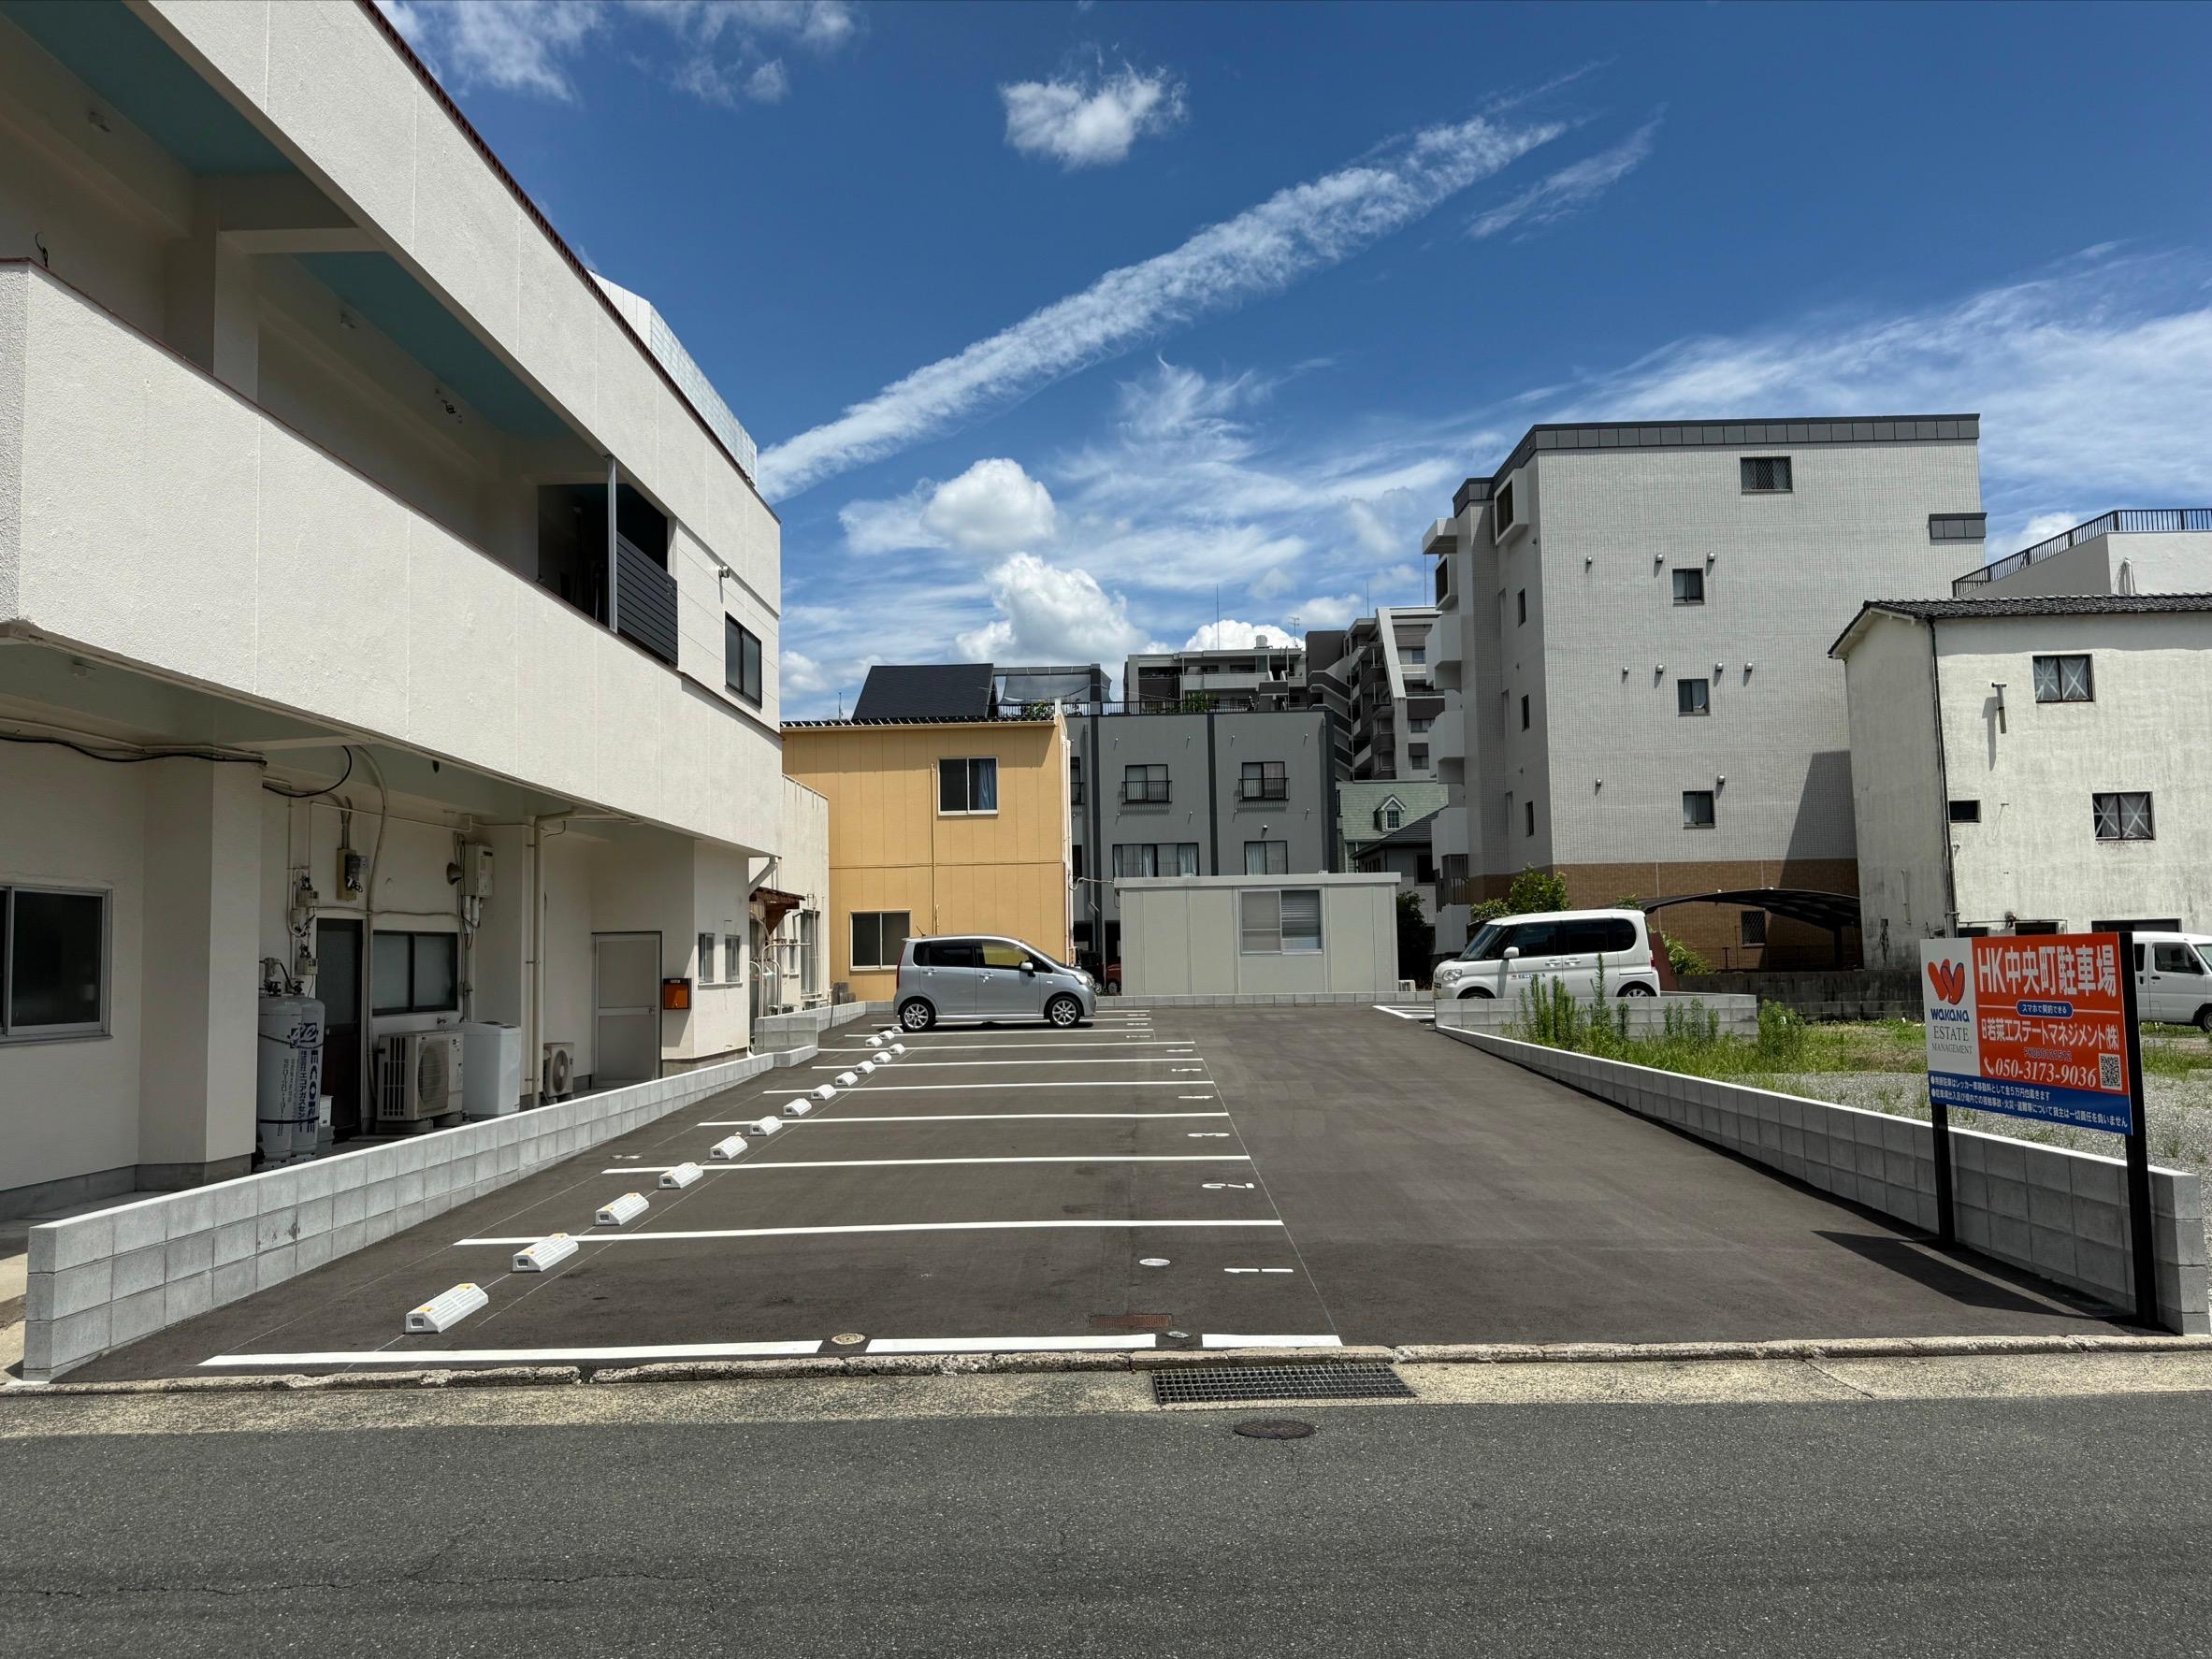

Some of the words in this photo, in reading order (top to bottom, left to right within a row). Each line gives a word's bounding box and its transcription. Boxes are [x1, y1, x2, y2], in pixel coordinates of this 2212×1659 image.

[1977, 944, 2117, 997] HK中央町駐車場
[2022, 1003, 2067, 1014] スマホで契約できる
[1933, 1025, 1969, 1042] ESTATE
[1931, 1043, 1973, 1055] MANAGEMENT
[1995, 1058, 2097, 1088] 050-3173-9036
